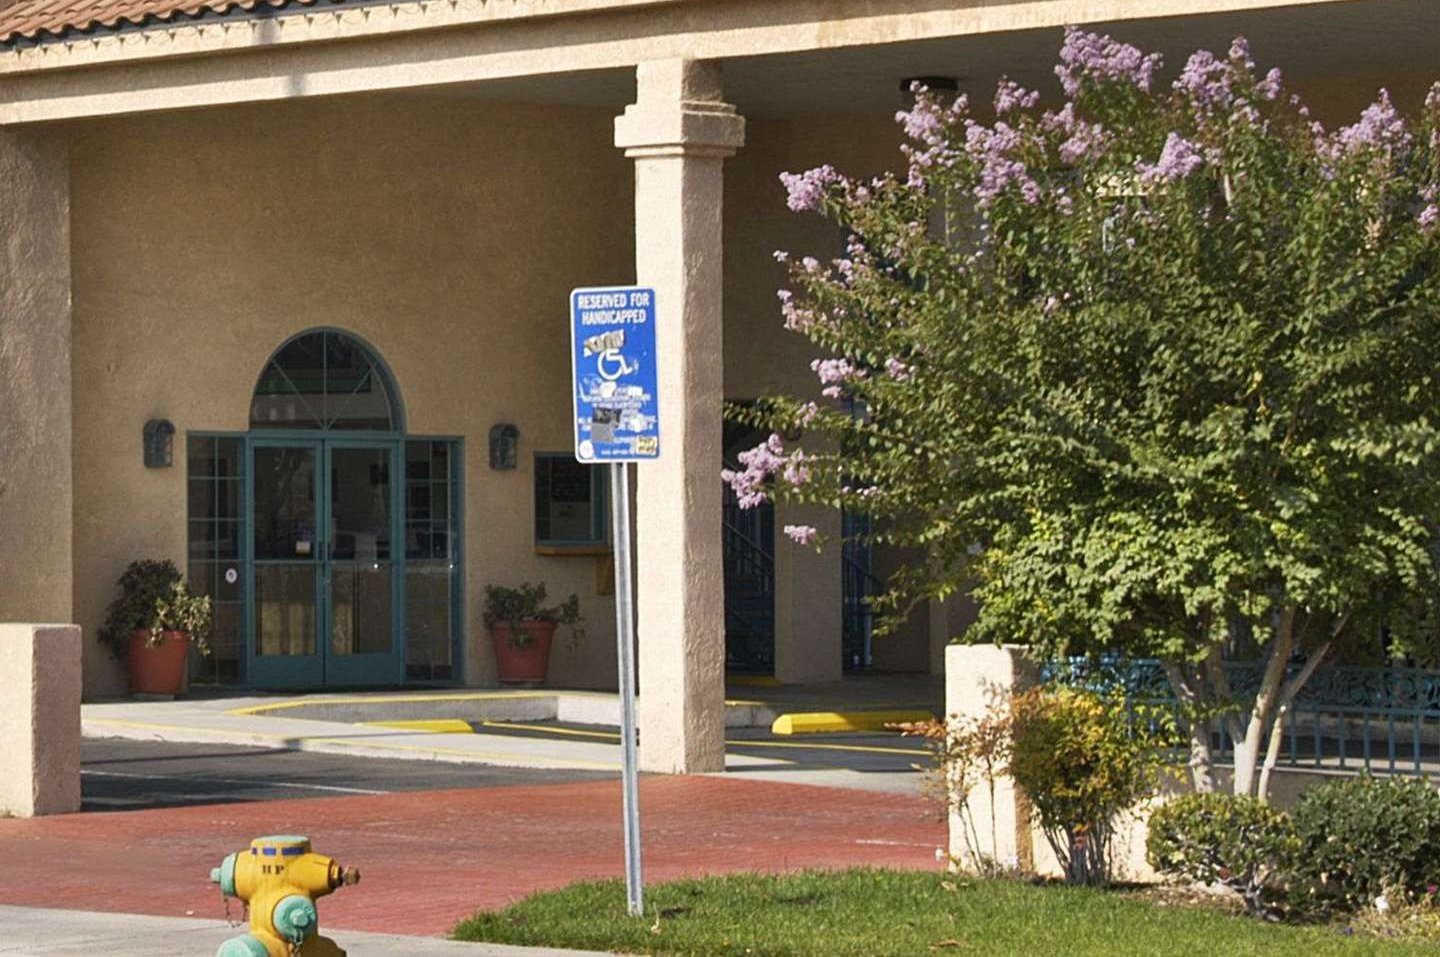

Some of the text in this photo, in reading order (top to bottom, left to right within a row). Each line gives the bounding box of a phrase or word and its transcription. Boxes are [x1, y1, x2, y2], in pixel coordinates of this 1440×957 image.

[577, 291, 651, 310] RESERVED FOR
[581, 309, 647, 326] HANDICAPPED
